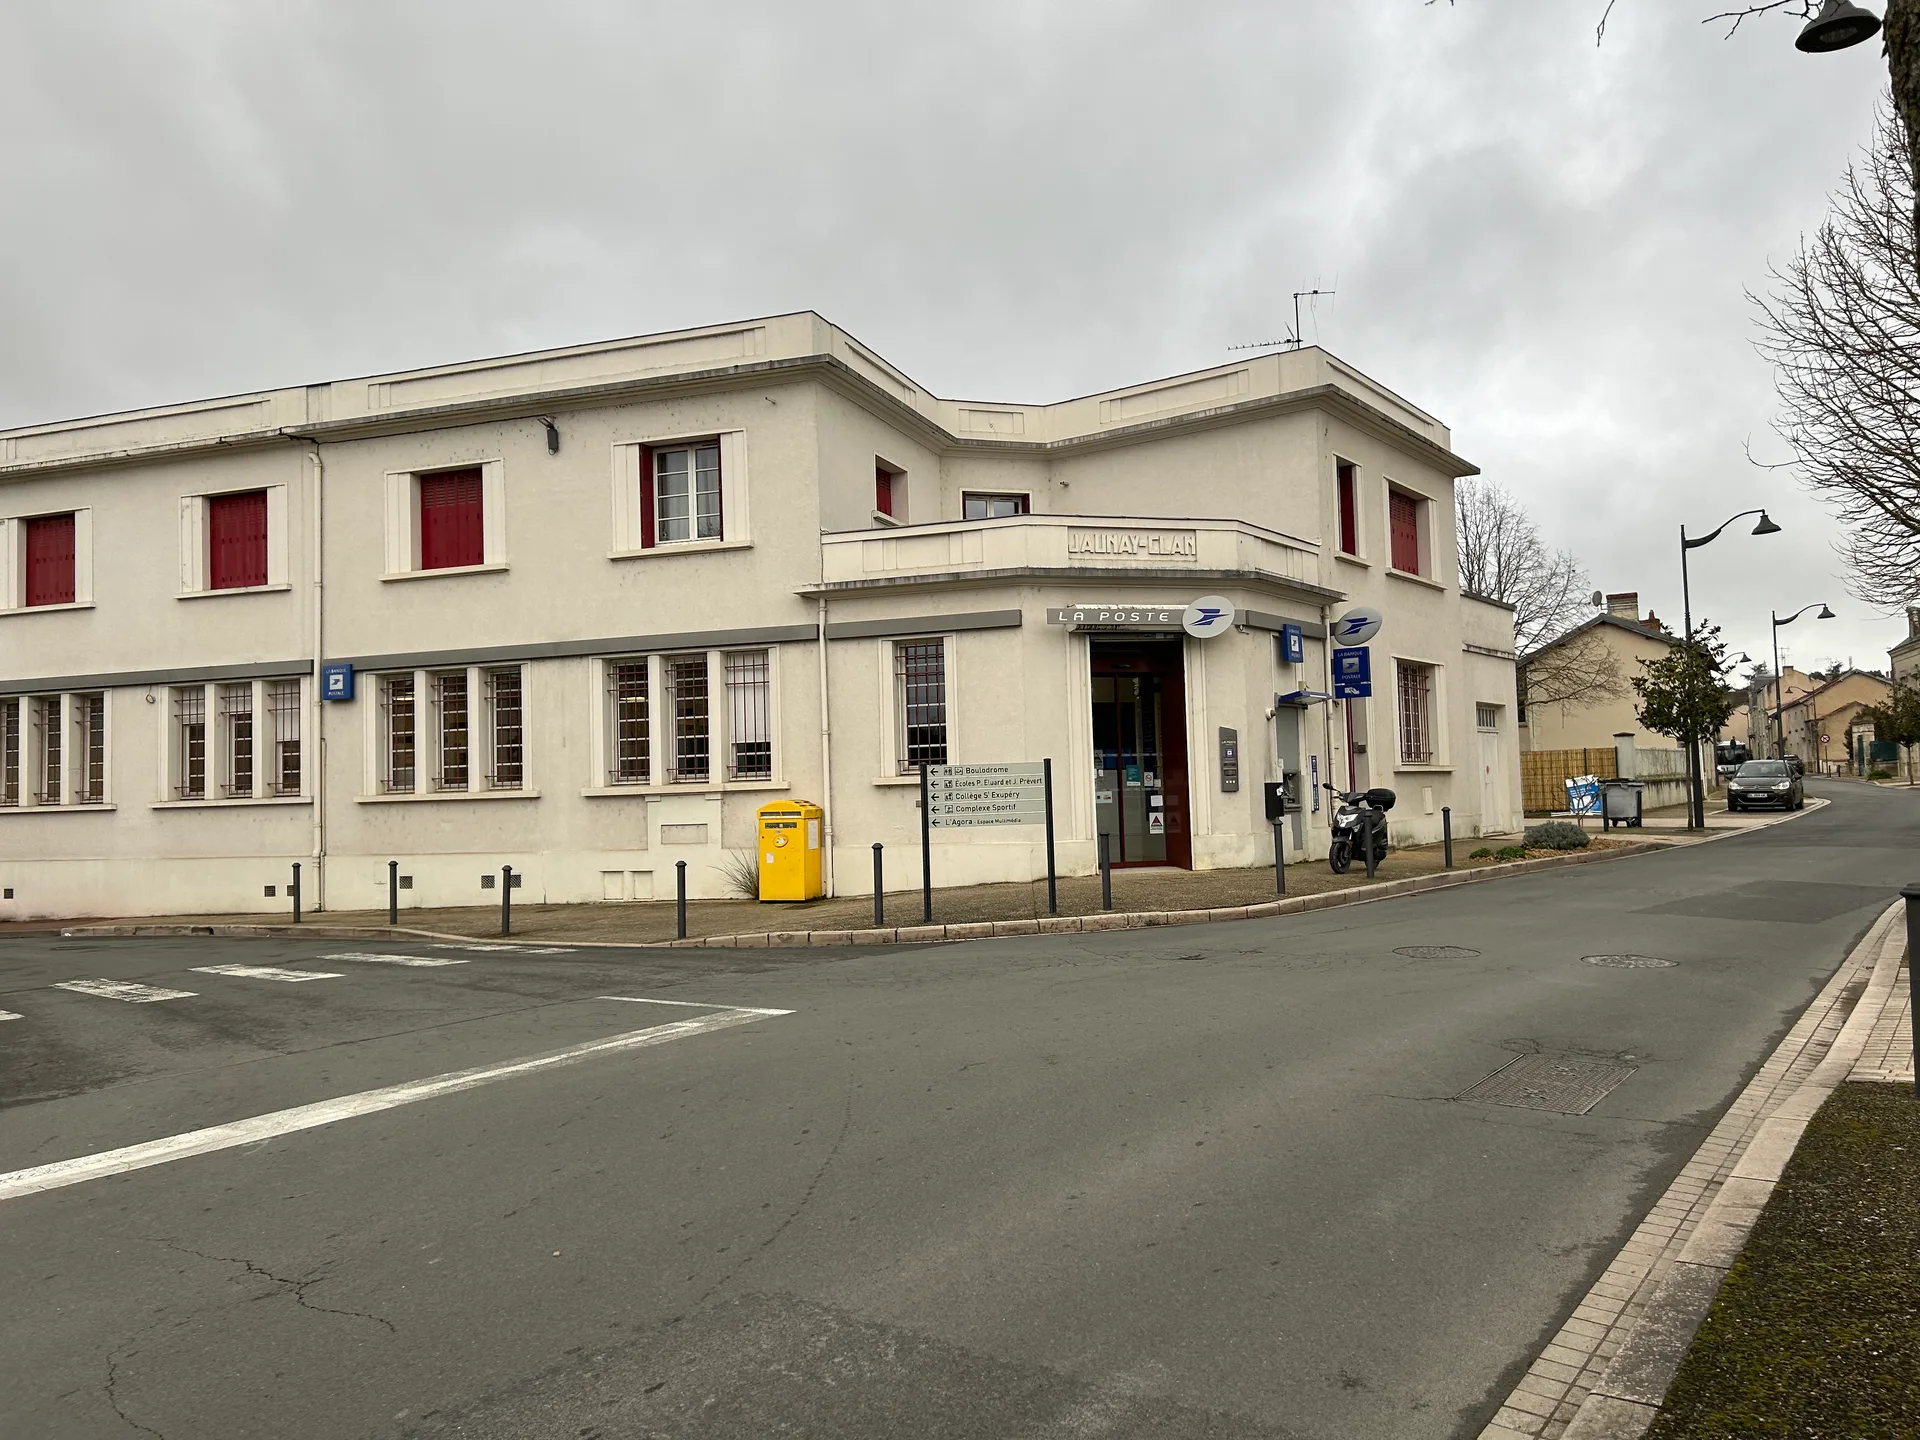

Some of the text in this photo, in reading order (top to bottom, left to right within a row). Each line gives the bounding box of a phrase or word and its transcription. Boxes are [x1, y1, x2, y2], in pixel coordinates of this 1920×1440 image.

[1068, 532, 1196, 556] JAUNAY-CLAN
[1058, 611, 1169, 622] LA POSTE
[965, 766, 1009, 774] Boulodrome
[955, 779, 975, 787] Écoles
[984, 778, 1004, 786] Éluard
[1019, 777, 1043, 785] Prévert
[955, 792, 982, 801] Collège
[991, 791, 1020, 799] Exupéry
[955, 803, 1016, 813] Complexe Sportif
[945, 818, 973, 827] L'Agora
